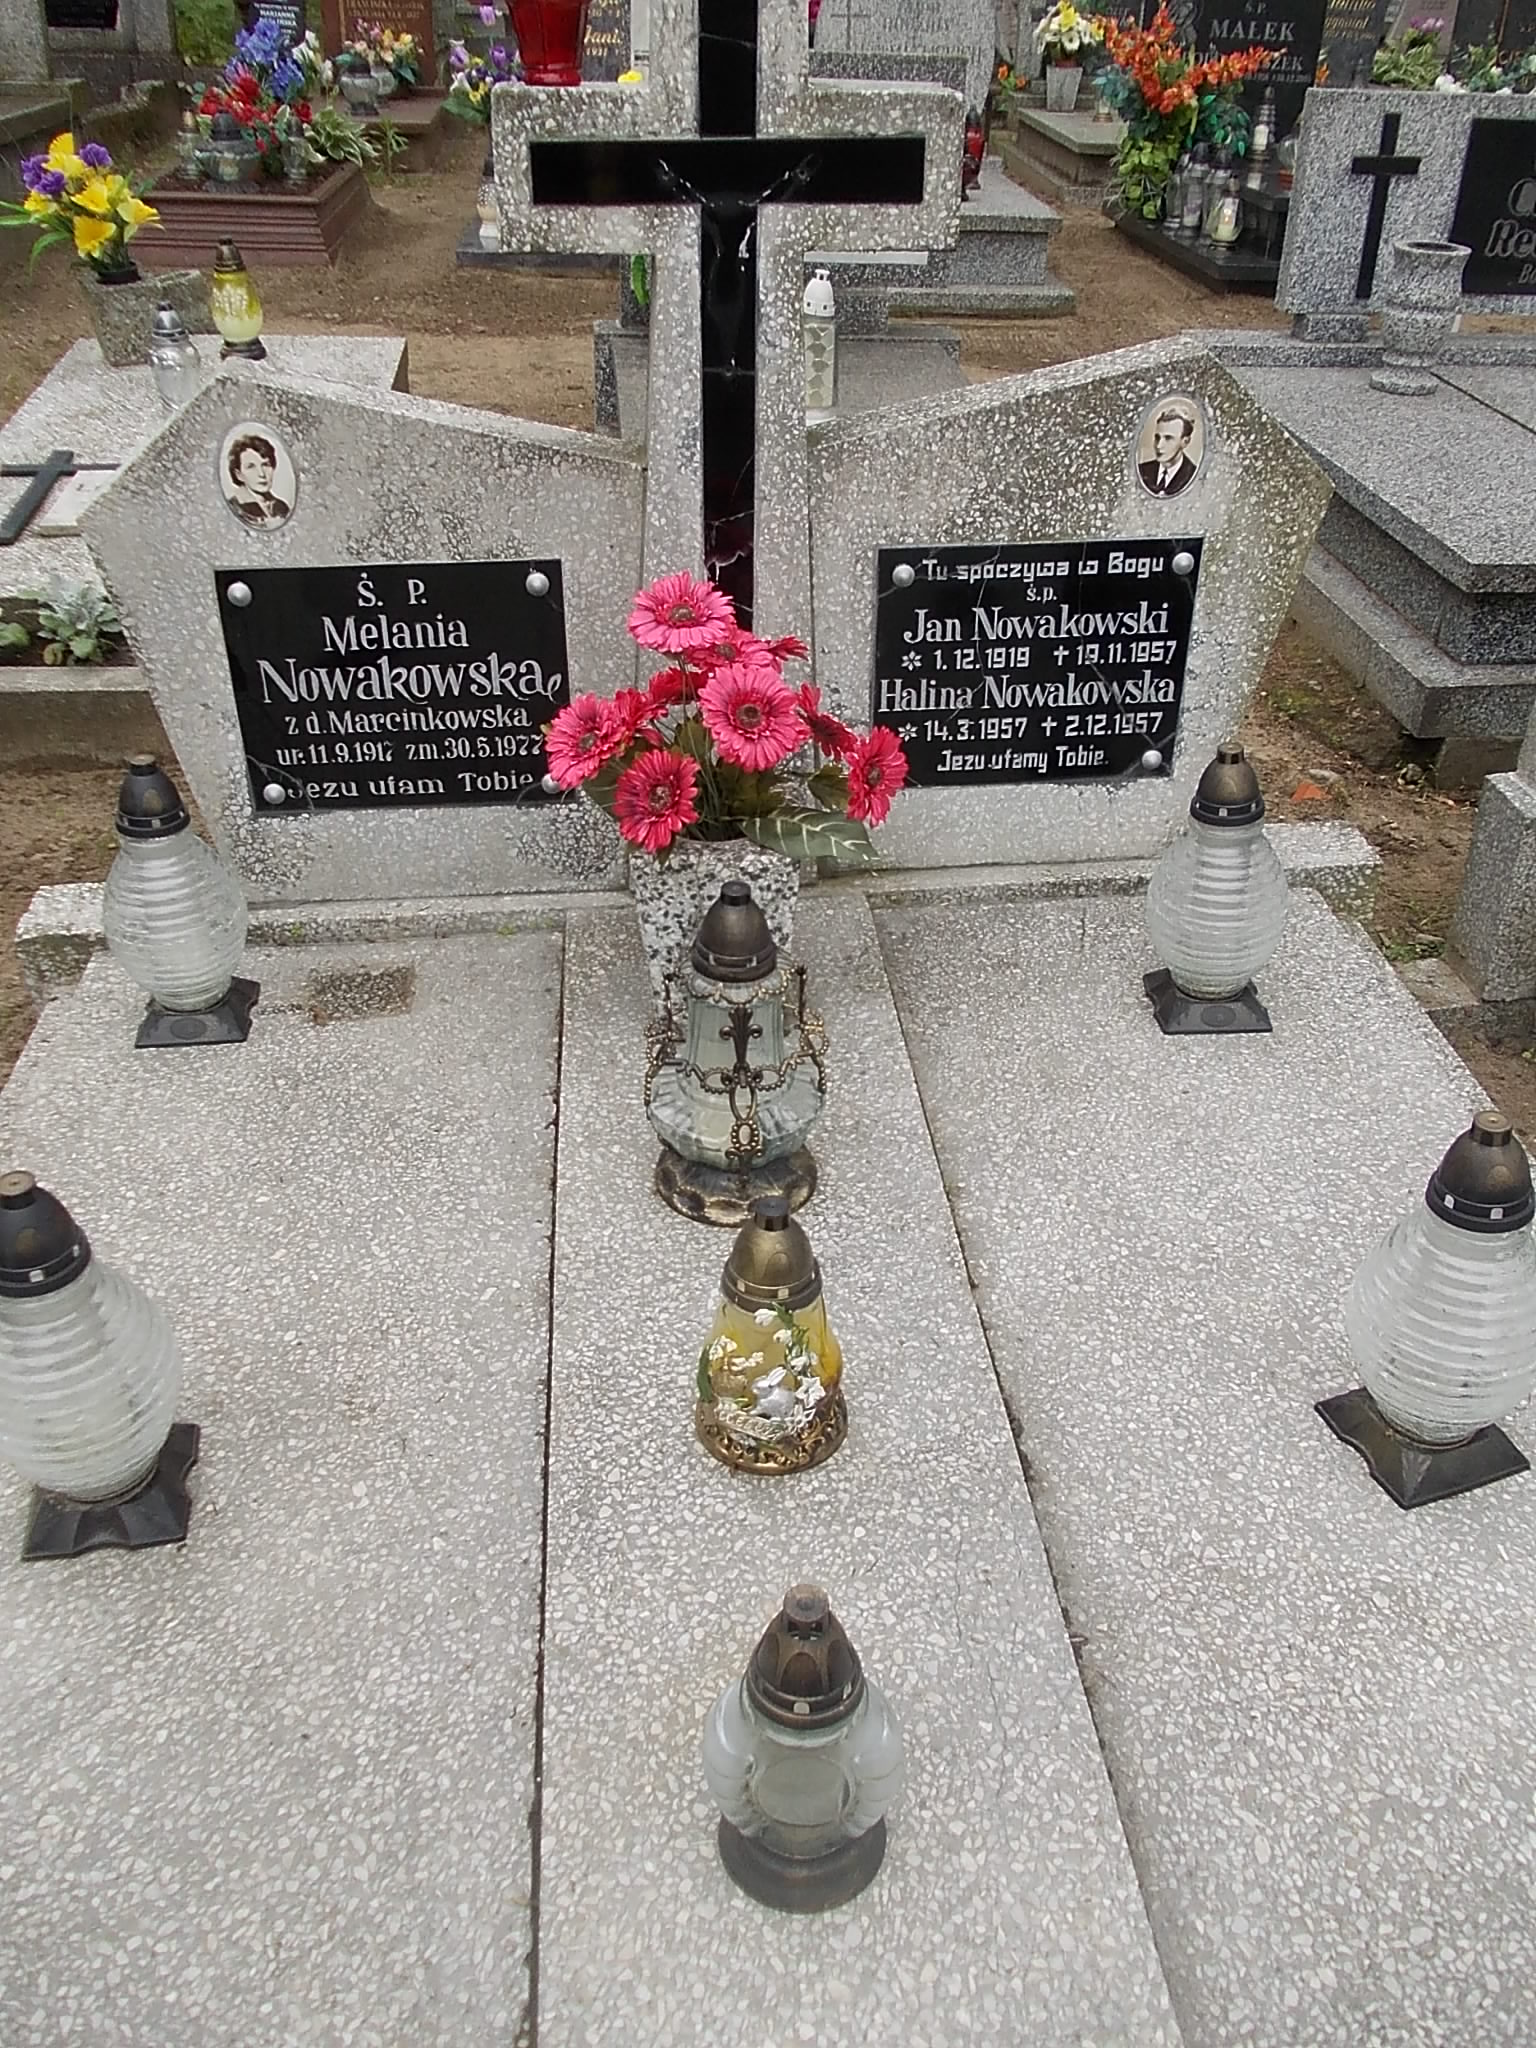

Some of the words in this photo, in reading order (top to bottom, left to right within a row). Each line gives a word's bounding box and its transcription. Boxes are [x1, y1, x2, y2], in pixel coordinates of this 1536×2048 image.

[922, 559, 948, 581] Tu
[956, 559, 1070, 584] spoczywa
[1108, 552, 1164, 578] Bogu
[321, 613, 469, 656] Melania
[903, 609, 962, 644] Jan
[970, 602, 1169, 641] Nowakowski
[256, 652, 562, 704] Nowakowska
[878, 679, 973, 712] Halina
[981, 670, 1175, 709] Nowakowska
[368, 776, 446, 796] ufam
[457, 770, 534, 792] Tobie
